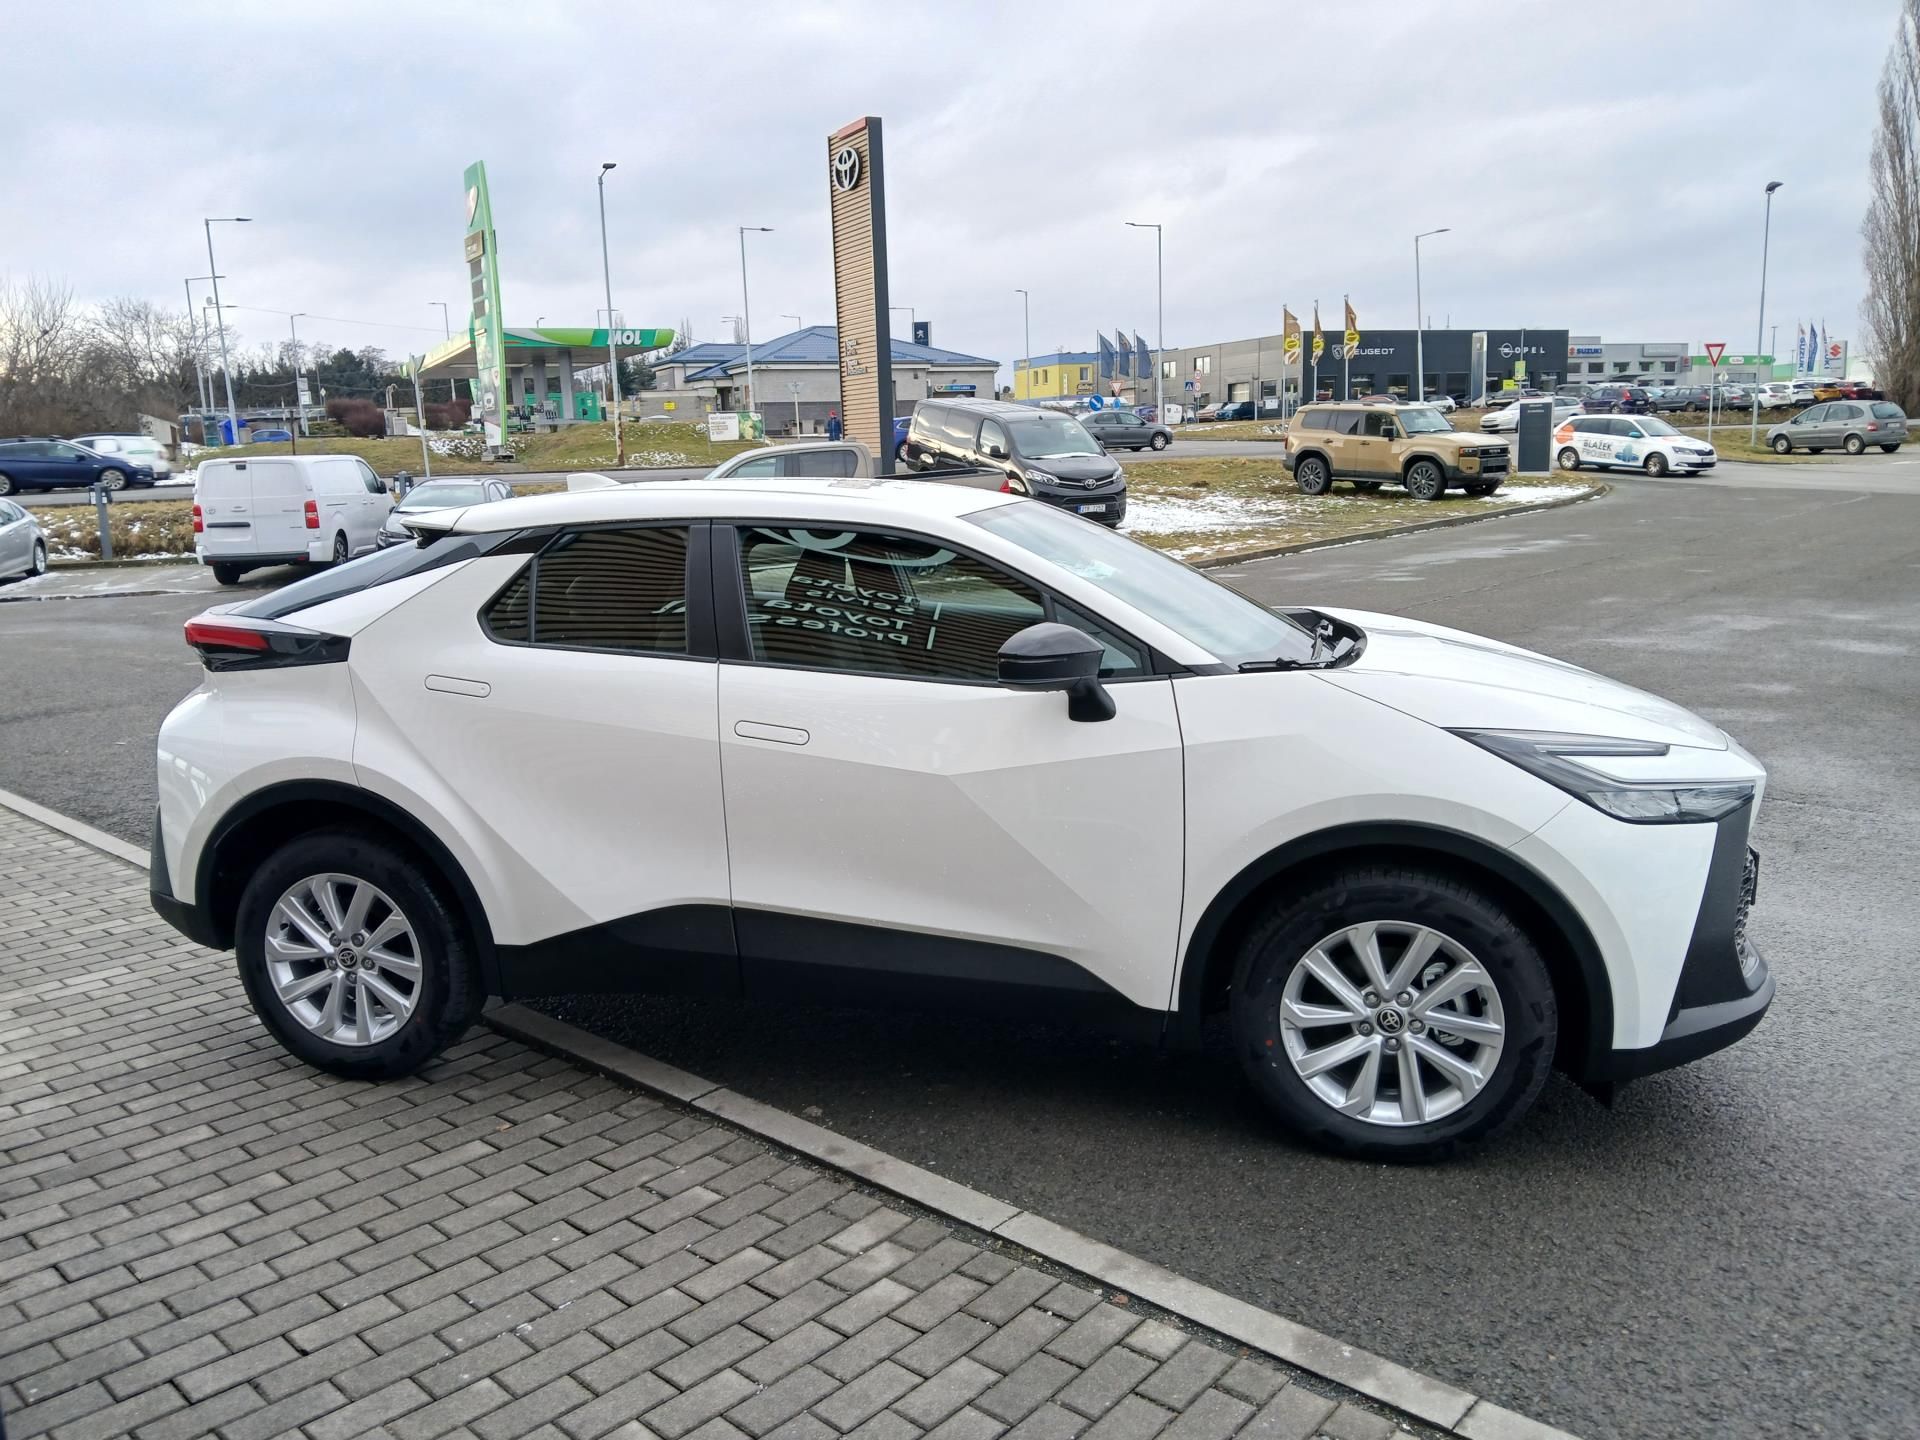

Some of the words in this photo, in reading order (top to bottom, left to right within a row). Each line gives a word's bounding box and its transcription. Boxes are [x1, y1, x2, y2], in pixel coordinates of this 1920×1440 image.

[607, 330, 642, 345] MOL
[1353, 347, 1395, 355] EUGEOT
[1514, 346, 1545, 354] OPEL
